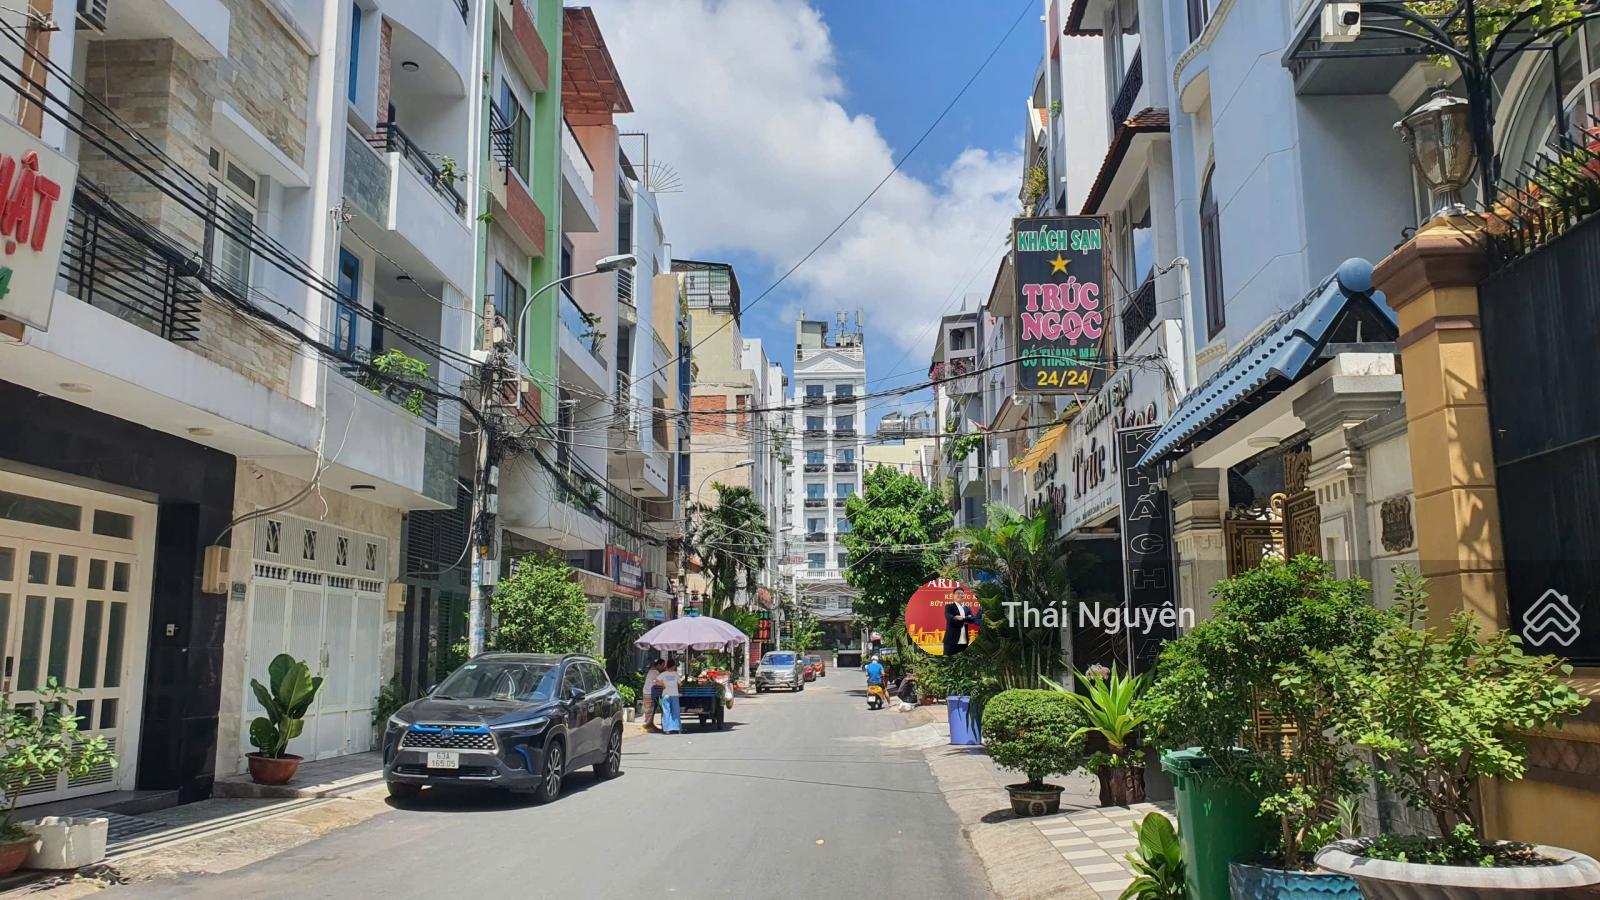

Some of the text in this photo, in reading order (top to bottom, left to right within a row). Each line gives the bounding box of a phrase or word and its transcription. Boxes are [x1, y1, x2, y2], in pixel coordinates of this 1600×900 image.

[1017, 225, 1101, 255] KHÁCH SẠN
[1022, 276, 1099, 311] TRÚC
[1020, 311, 1102, 345] NGỌC
[1040, 348, 1077, 367] THANG
[1037, 369, 1089, 387] 24/24
[1072, 437, 1106, 499] Trúc
